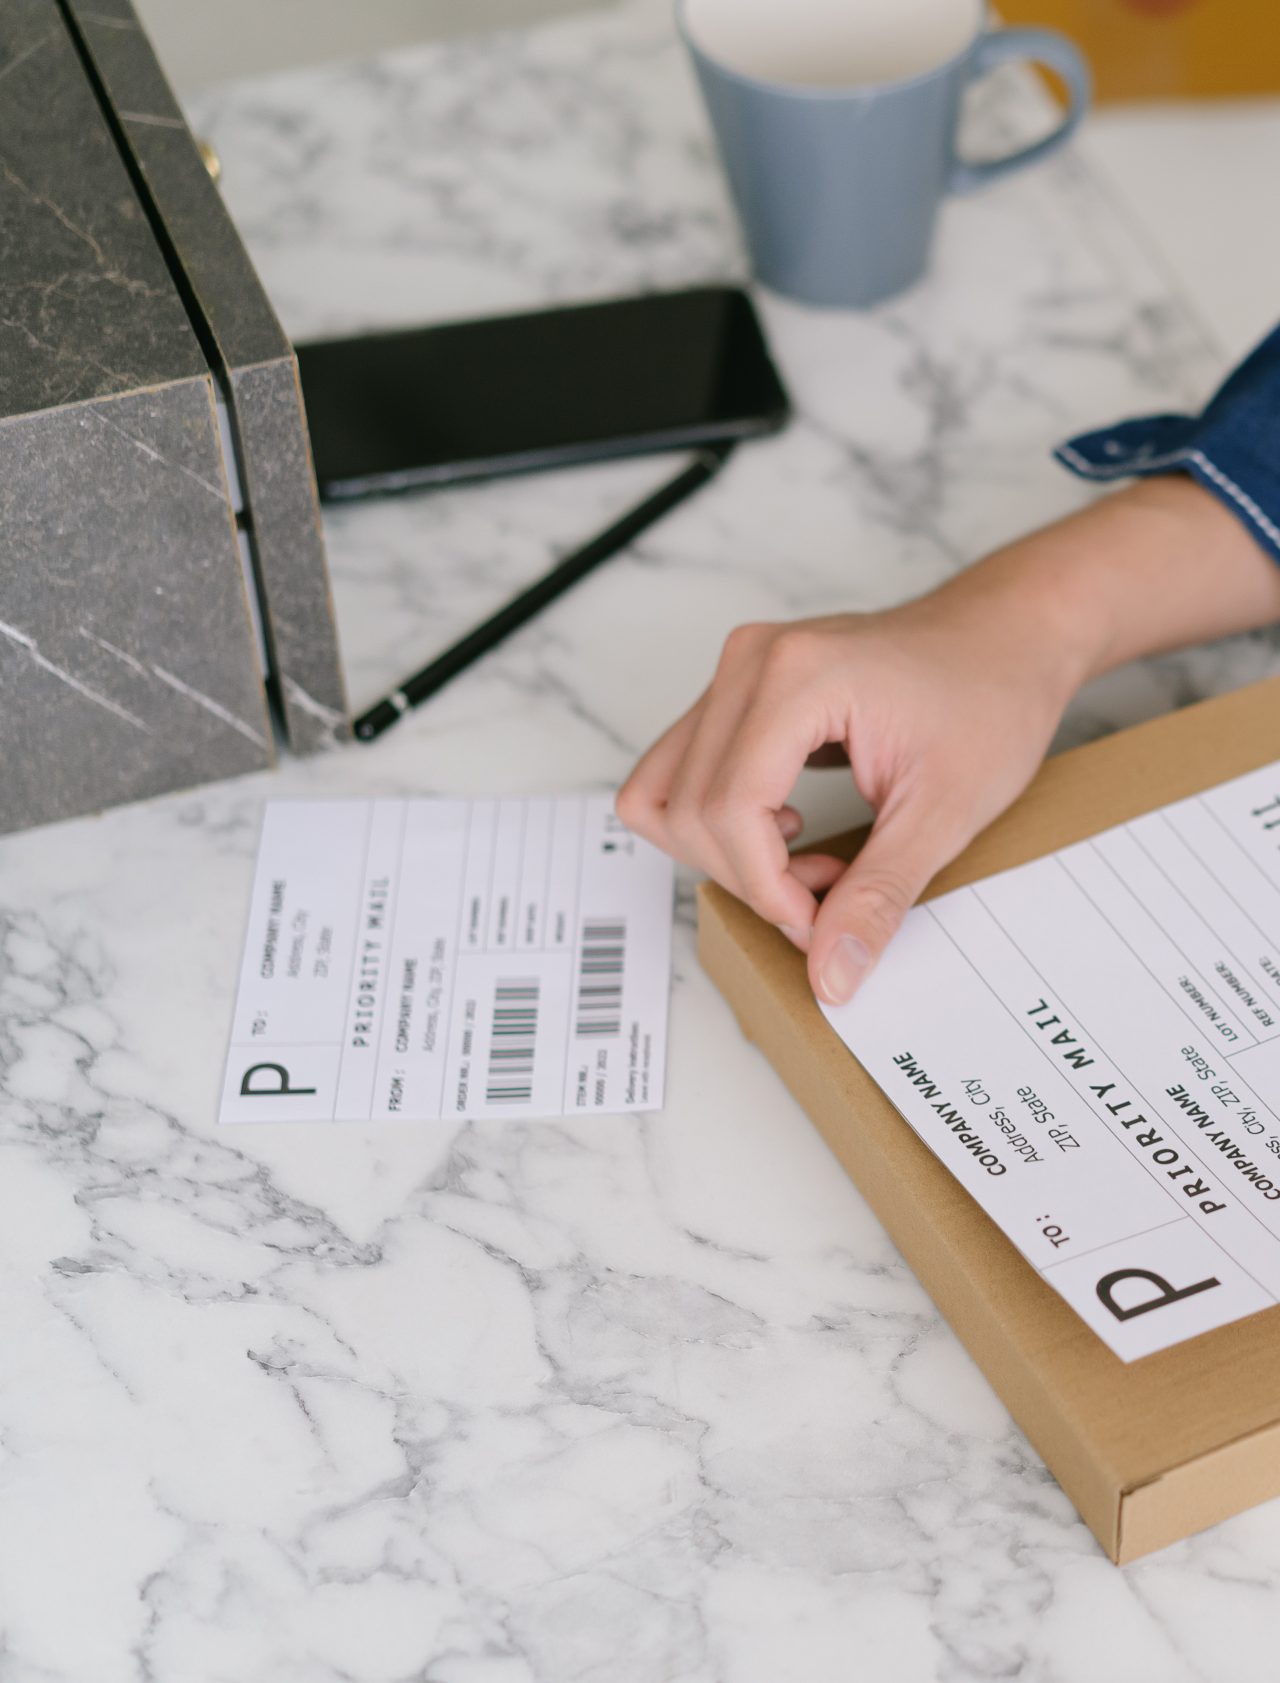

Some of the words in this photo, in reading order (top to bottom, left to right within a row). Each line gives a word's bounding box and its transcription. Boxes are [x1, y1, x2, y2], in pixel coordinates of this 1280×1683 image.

[269, 881, 286, 916] NAME
[260, 918, 279, 979] COMPANY
[352, 940, 380, 1047] PRIORITY
[367, 879, 389, 929] MAIL
[402, 959, 417, 992] NAME
[1214, 960, 1257, 1007] NUMBER:
[1178, 974, 1221, 1021] NUMBER:
[251, 1019, 266, 1036] TO
[395, 995, 412, 1053] COMPANY
[1027, 999, 1094, 1069] MAIL
[1215, 1023, 1239, 1042] LOT
[1252, 1009, 1275, 1027] REF
[240, 1062, 316, 1096] P
[893, 1052, 942, 1099] NAME
[1181, 1046, 1216, 1080] State
[388, 1078, 403, 1111] FROM
[961, 1079, 990, 1105] City
[1017, 1086, 1055, 1123] State
[1165, 1084, 1215, 1129] NAME
[1211, 1081, 1240, 1107] ZIP,
[989, 1107, 1044, 1162] Address,
[1048, 1125, 1080, 1152] ZIP,
[1236, 1108, 1265, 1134] City,
[931, 1103, 1006, 1176] COMPANY
[1089, 1083, 1227, 1214] PRIORITY
[1042, 1225, 1070, 1248] TO
[1096, 1268, 1221, 1322] P
